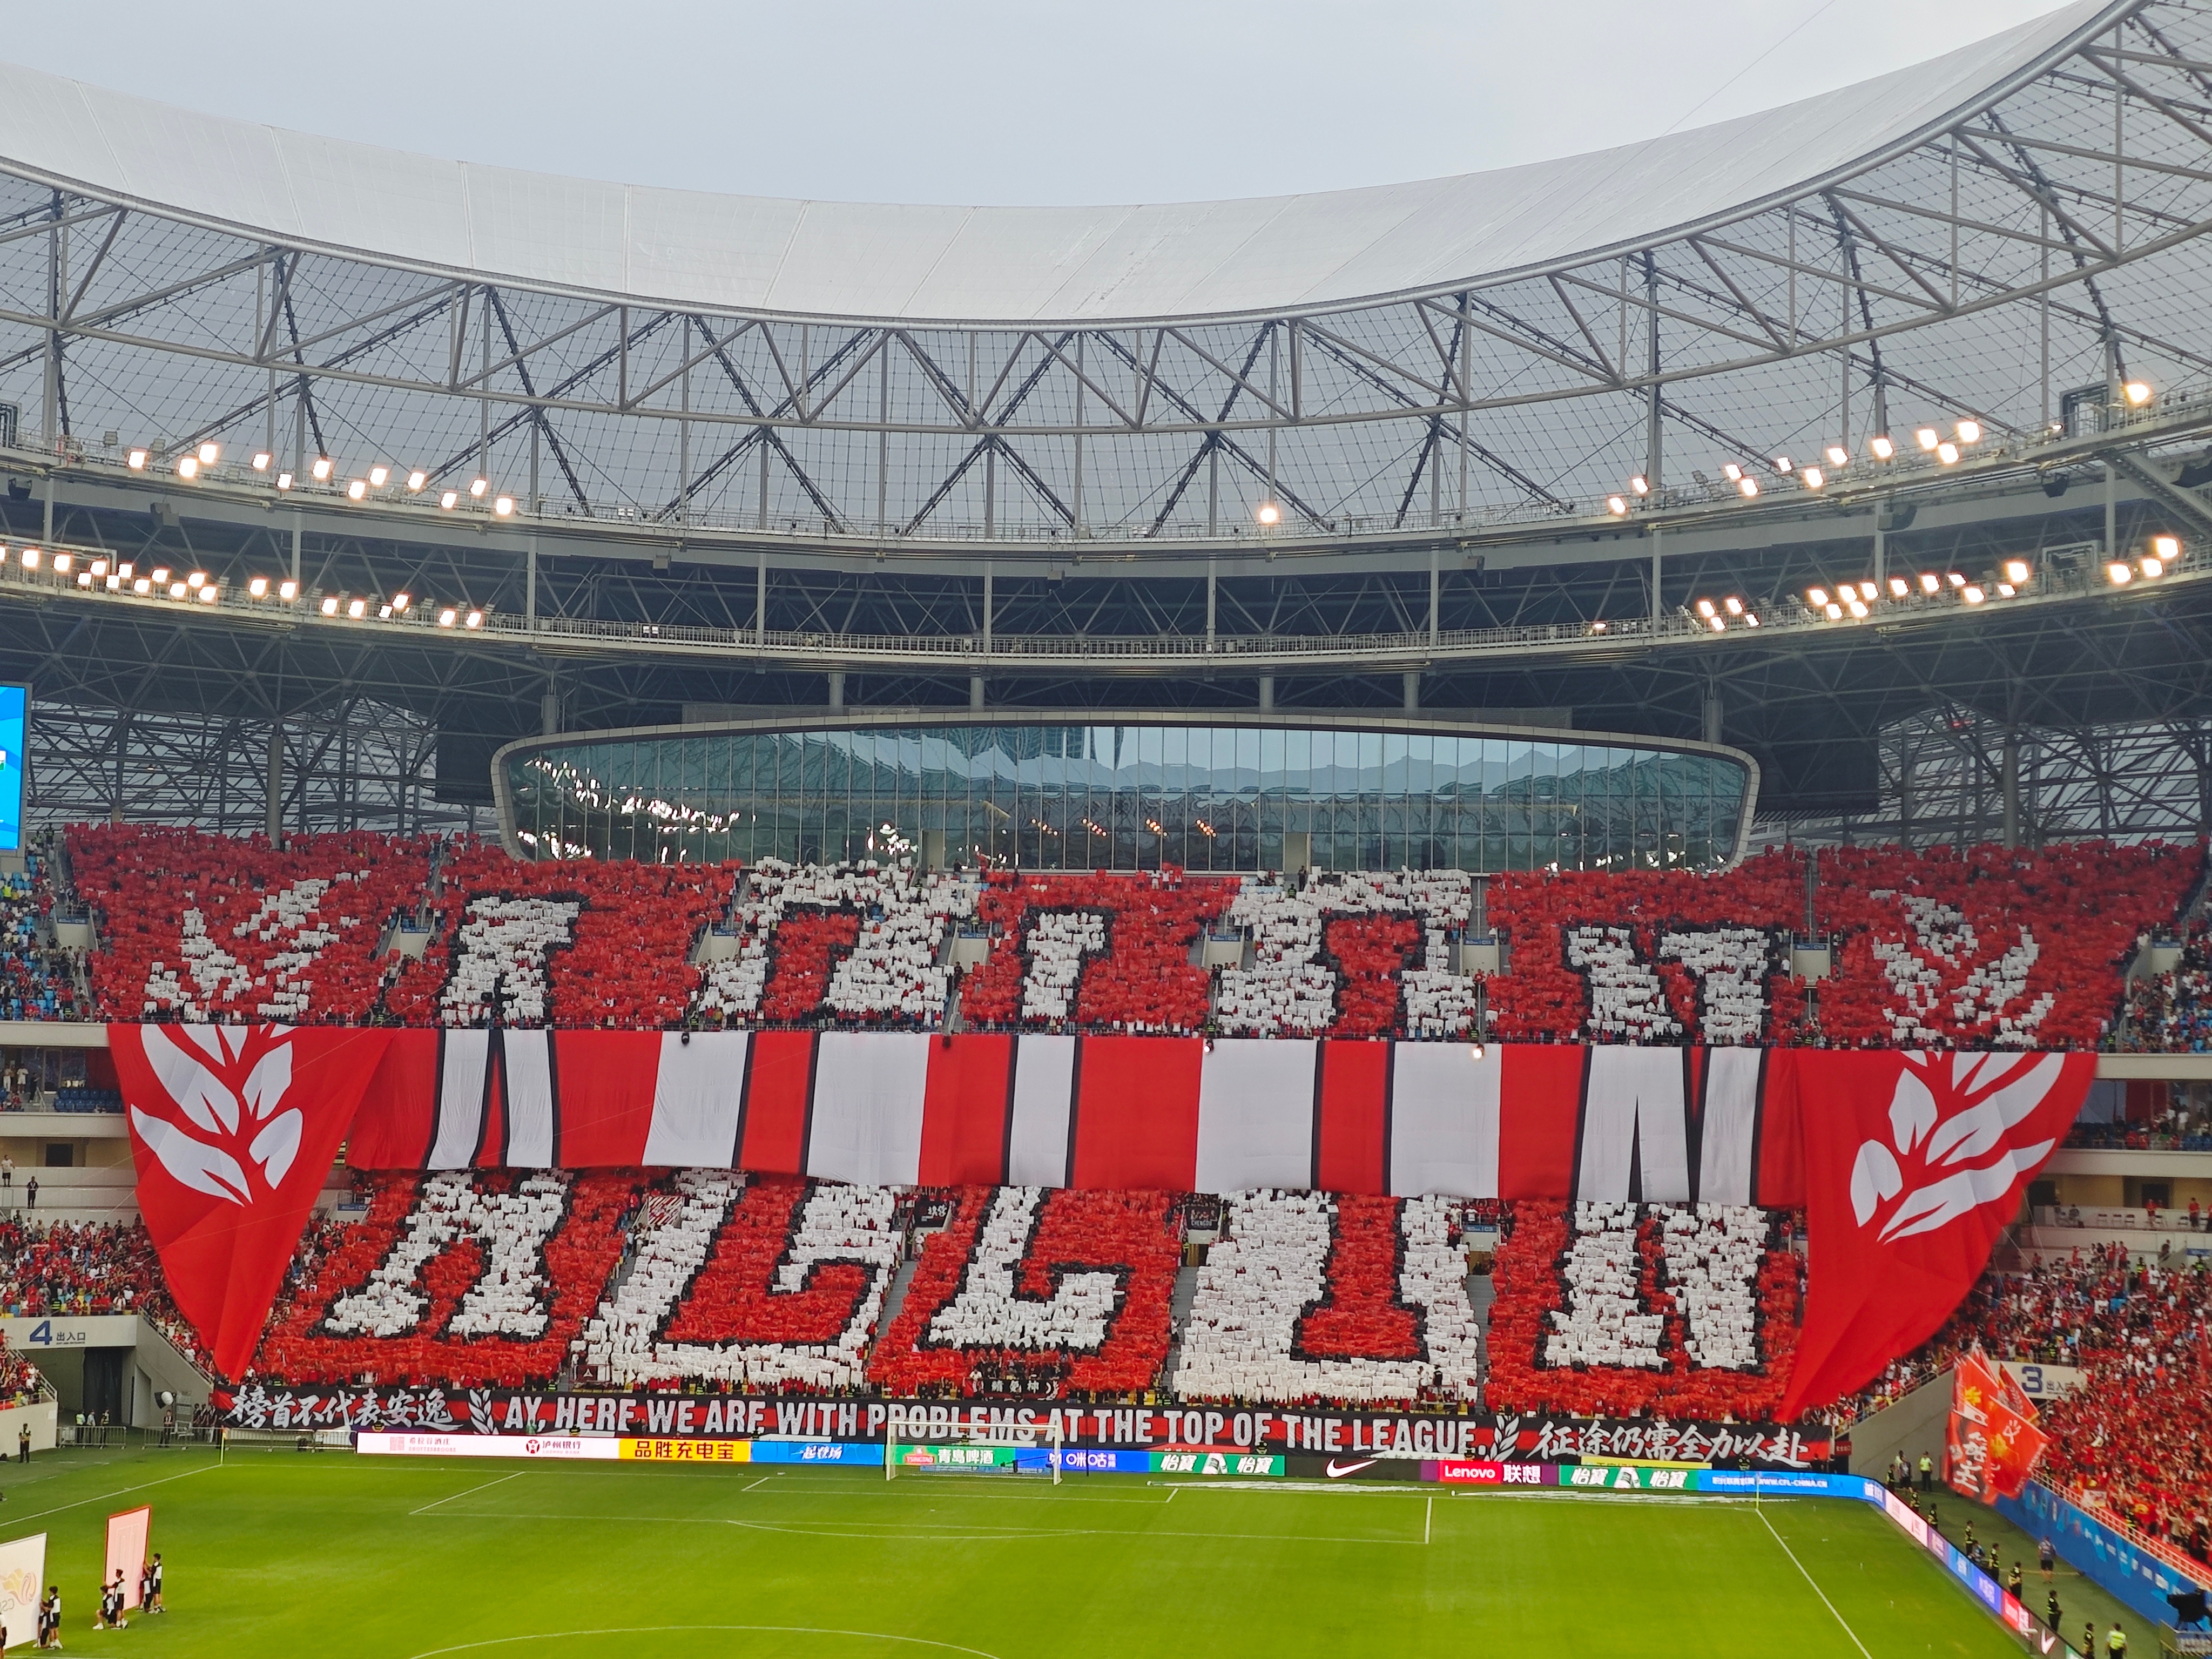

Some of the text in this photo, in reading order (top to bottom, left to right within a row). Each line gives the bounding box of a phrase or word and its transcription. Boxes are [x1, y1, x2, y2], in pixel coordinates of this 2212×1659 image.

[29, 1320, 53, 1345] 4
[56, 1331, 85, 1341] 出入口
[2021, 1366, 2042, 1393] 3
[221, 1385, 464, 1431] 榜首不代表安逸
[554, 1396, 638, 1432] HERE
[646, 1399, 696, 1434] WE
[704, 1399, 766, 1434] ARE
[775, 1402, 859, 1437] WITH
[867, 1403, 1043, 1441] PROBLEMS
[1045, 1407, 1084, 1444] AT
[1093, 1408, 1154, 1444] THE
[1163, 1410, 1224, 1446] TOP
[1233, 1412, 1273, 1446] OF
[1281, 1413, 1344, 1453] THE
[1352, 1418, 1486, 1456] LEAGUE.
[542, 1440, 581, 1449] 泸州银行
[634, 1441, 734, 1460] 品胜充电宝
[1526, 1419, 1812, 1469] 征途仍需全力以赴
[938, 1448, 994, 1465] 青岛啤酒
[1444, 1465, 1496, 1479] Lenovo
[1502, 1464, 1542, 1485] 联想
